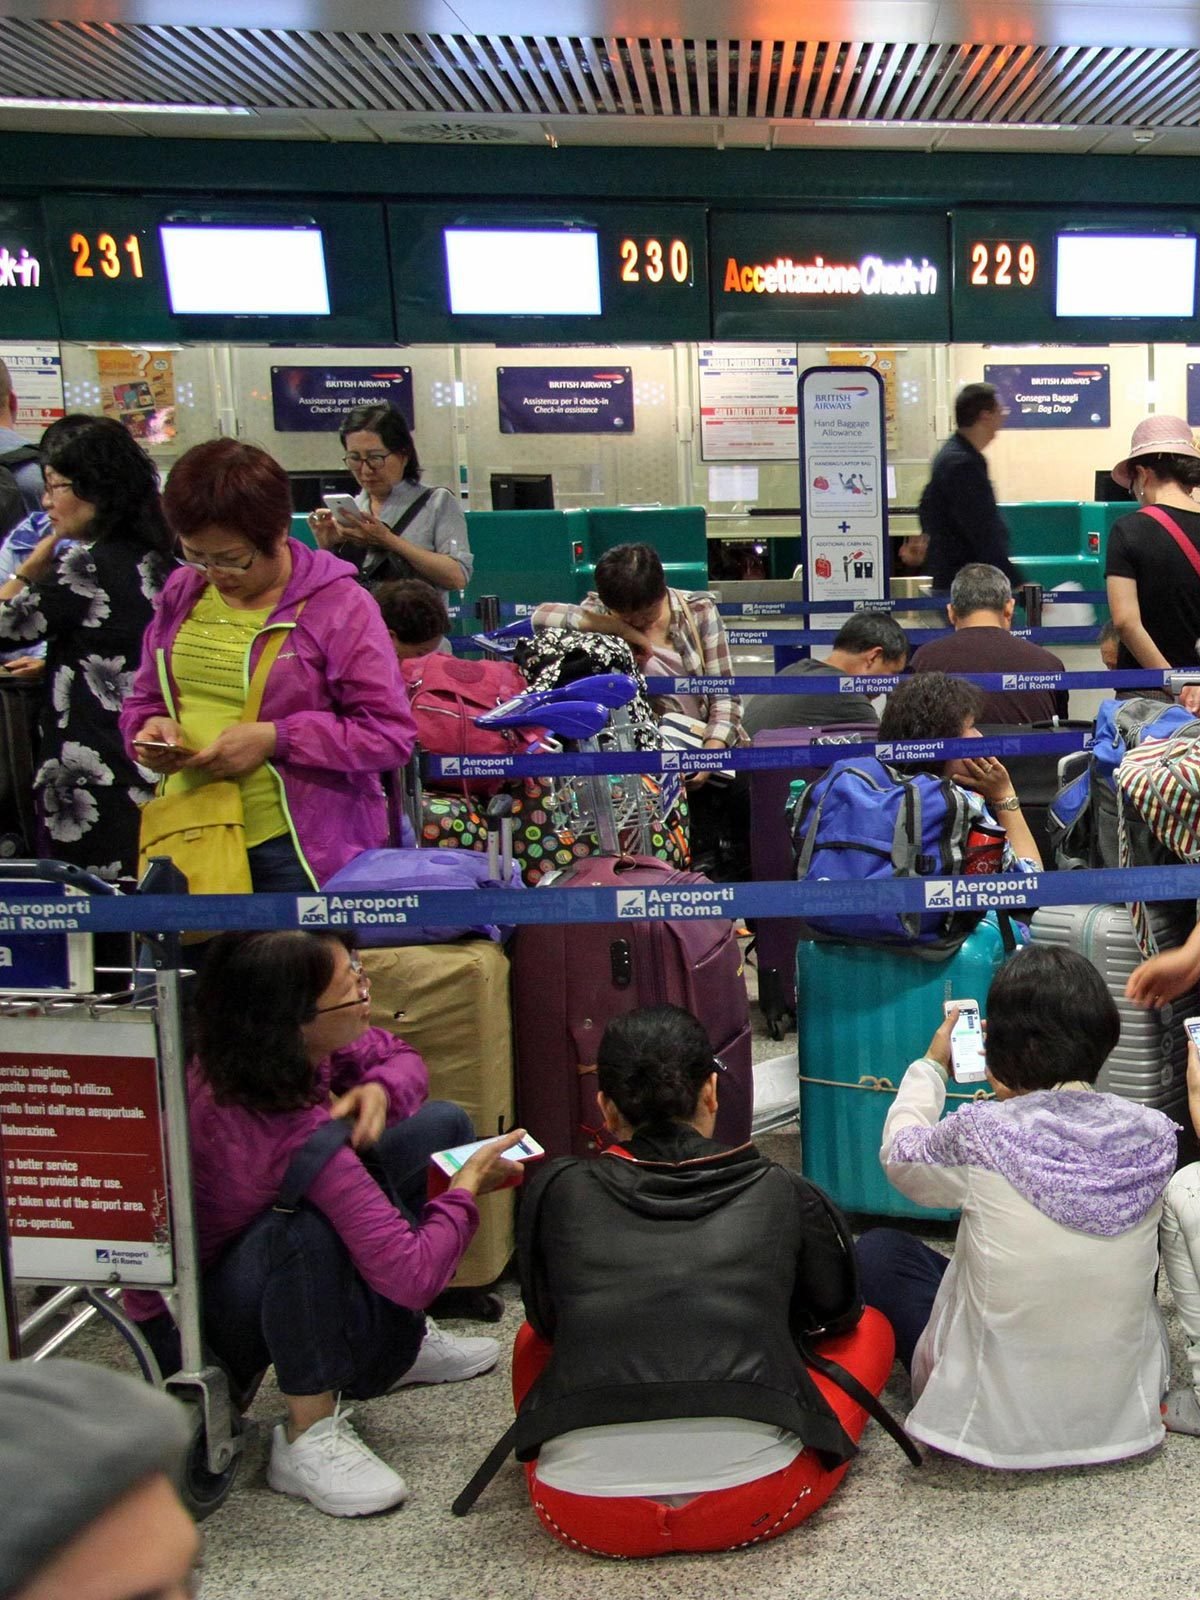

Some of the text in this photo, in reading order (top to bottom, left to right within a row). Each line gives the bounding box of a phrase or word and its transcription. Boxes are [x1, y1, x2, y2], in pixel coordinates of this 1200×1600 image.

[70, 231, 145, 279] 231
[621, 239, 689, 283] 230
[971, 243, 1036, 286] 229
[0, 248, 40, 287] k-in
[724, 255, 938, 296] Accettazione Check-in
[325, 380, 391, 388] BRITISH AIRWAYS
[549, 381, 612, 389] BRITISH AIRWAYS
[1031, 377, 1091, 385] BRITISH AIRWAYS
[299, 397, 336, 405] Assistenza
[337, 399, 349, 407] per
[523, 397, 559, 405] Assistenza
[560, 399, 572, 407] per
[579, 397, 609, 405] check-in
[815, 394, 851, 402] BRITISH
[1015, 393, 1078, 404] Consegna Bagagli
[310, 406, 340, 414] Check-in
[534, 406, 598, 414] Check-in assistance
[814, 402, 852, 410] AIRWAYS
[1053, 404, 1072, 414] Drop
[814, 420, 870, 429] Hand Baggage
[822, 429, 863, 437] Allowance
[730, 631, 768, 639] Aeroporti
[691, 678, 735, 687] Aeroporti
[855, 676, 899, 685] Aeroporti
[1018, 674, 1061, 683] Aeroporti
[895, 742, 944, 752] Aeroporti
[682, 751, 732, 761] Aeroporti
[895, 751, 935, 760] di Roma
[462, 757, 514, 767] Aeroporti
[682, 761, 723, 769] di Roma
[463, 767, 505, 775] di Roma
[955, 877, 1038, 894] Aeroporti
[648, 887, 734, 904] Aeroporti
[955, 893, 1026, 907] di Roma
[330, 895, 419, 911] Aeroporti
[928, 897, 951, 906] ADR
[0, 901, 91, 918] Aeroporti
[620, 907, 644, 915] ADR
[648, 904, 722, 917] di Roma
[302, 914, 325, 923] ADR
[330, 911, 407, 924] di Roma
[0, 917, 78, 930] di Roma
[0, 1066, 29, 1077] ervizio
[0, 1081, 26, 1094] posite
[28, 1083, 48, 1093] aree
[50, 1082, 72, 1096] dopo
[0, 1103, 146, 1120] rrello fuori dall'area aeroportuale.
[2, 1124, 57, 1136] llaborazione.
[17, 1158, 43, 1170] better
[46, 1160, 78, 1172] service
[14, 1175, 38, 1185] areas
[40, 1175, 78, 1188] provided
[80, 1176, 101, 1187] after
[104, 1179, 123, 1189] use.
[18, 1195, 146, 1212] taken out of the airport area.
[16, 1217, 75, 1230] co-operation.
[111, 1250, 149, 1258] Aeroporti
[120, 1257, 142, 1265] Roma
